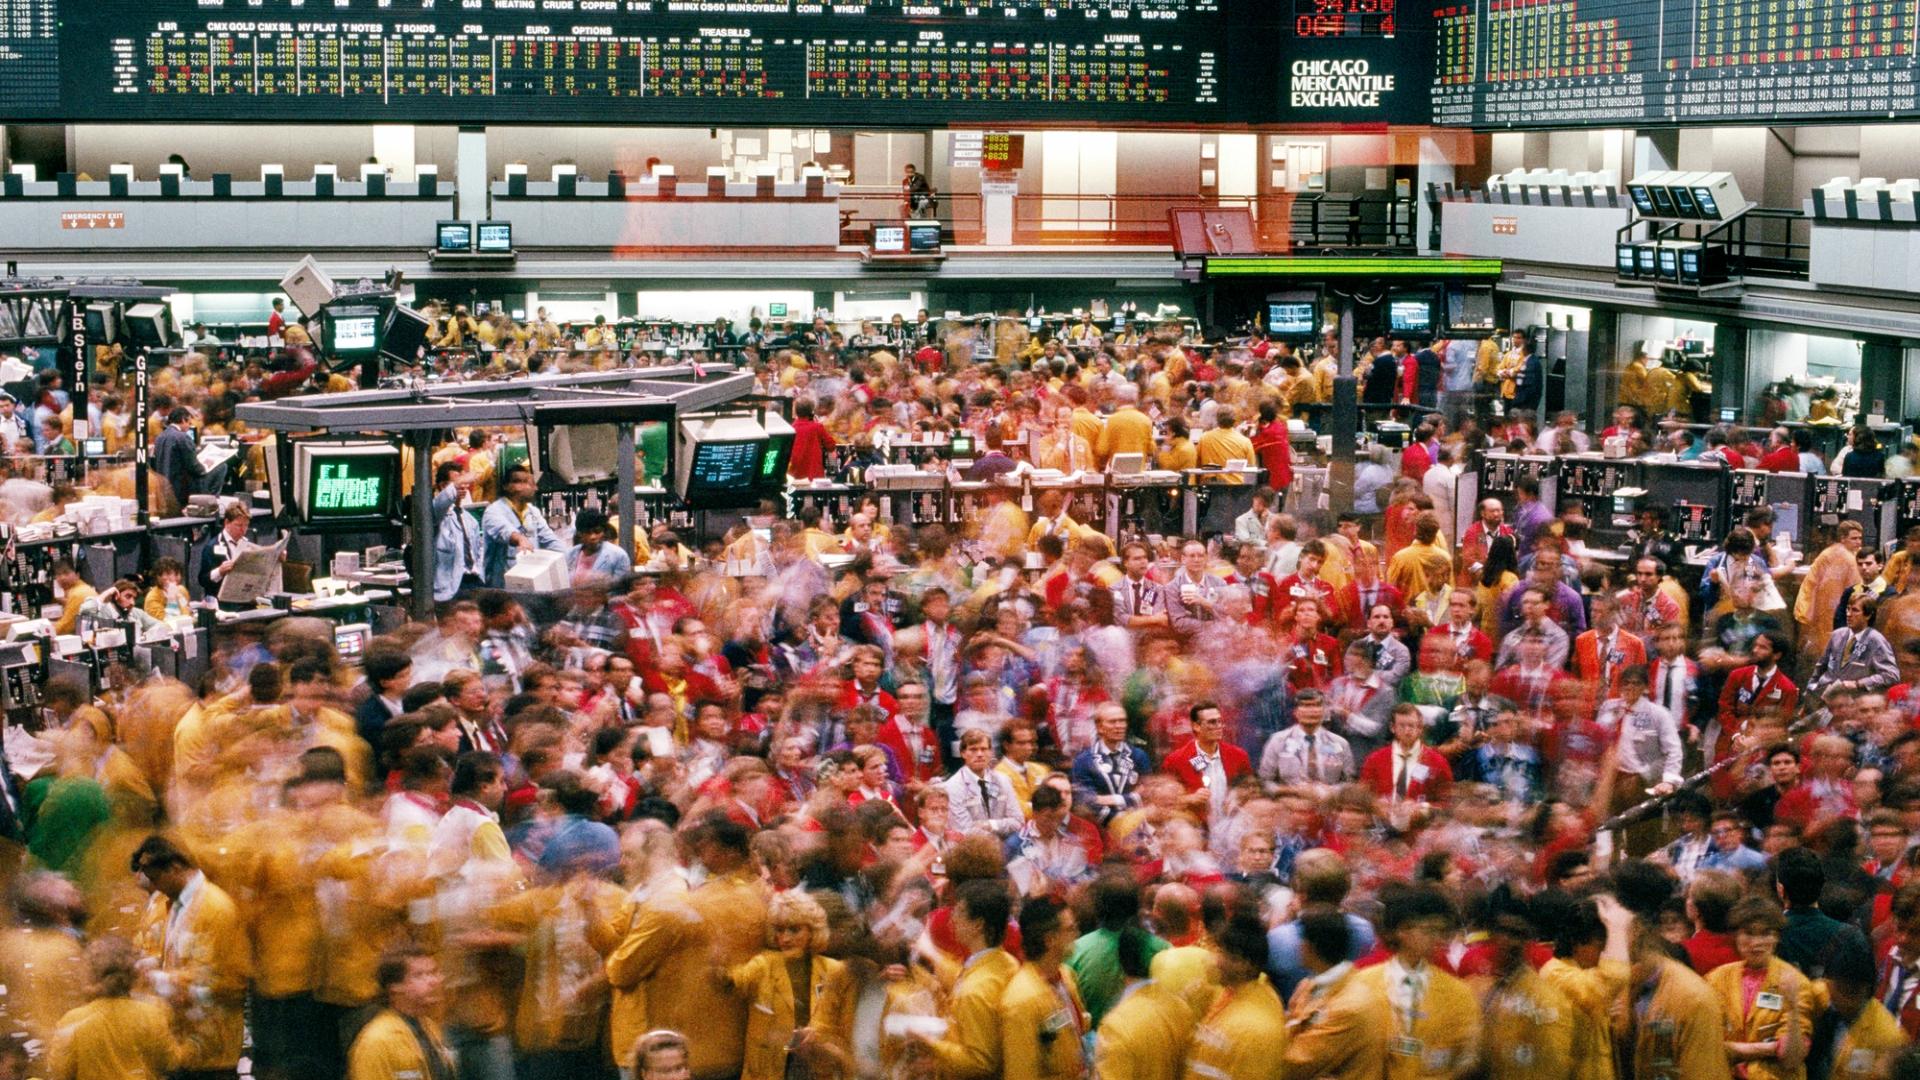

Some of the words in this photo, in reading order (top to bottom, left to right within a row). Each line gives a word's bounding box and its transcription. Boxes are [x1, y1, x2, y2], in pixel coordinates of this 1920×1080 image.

[745, 4, 788, 12] SOYBEAN
[158, 22, 177, 30] LBR
[207, 22, 227, 31] CMX
[229, 22, 255, 31] GOLD
[258, 23, 278, 31] CMX
[279, 23, 294, 31] SIL
[313, 23, 337, 31] PLAT
[342, 24, 348, 32] T
[351, 24, 383, 32] NOTES
[395, 24, 402, 32] T
[403, 24, 435, 33] BONDS
[463, 25, 482, 33] CRB
[1297, 15, 1344, 37] OCT
[1380, 14, 1394, 35] 4
[526, 26, 550, 34] EURO
[572, 26, 612, 35] OPTIONS
[1104, 35, 1140, 43] LUMBER
[1292, 60, 1369, 75] CHICAGO
[1291, 76, 1394, 91] MERCANTILE
[1291, 92, 1380, 107] EXCHANGE
[74, 334, 84, 392] Stern
[136, 356, 146, 463] GRIFFIN
